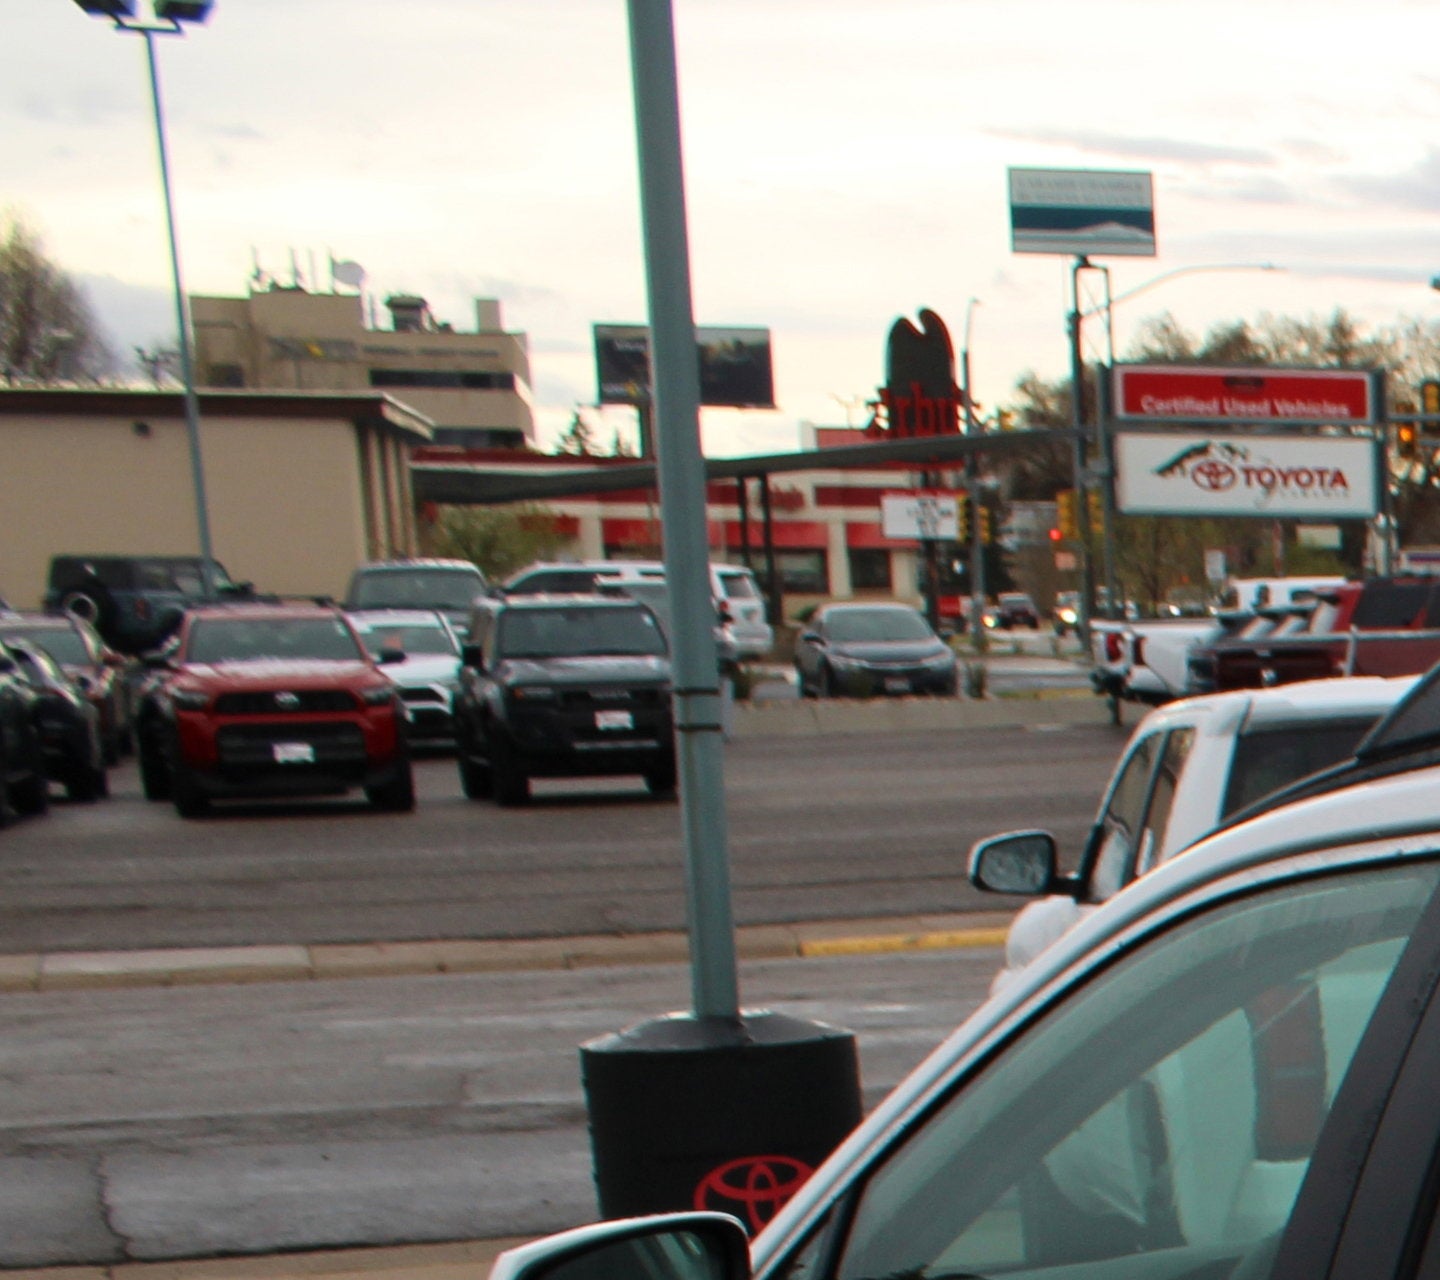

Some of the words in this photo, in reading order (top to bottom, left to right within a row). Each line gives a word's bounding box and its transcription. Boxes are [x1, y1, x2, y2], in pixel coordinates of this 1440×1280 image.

[1140, 395, 1220, 415] Certified
[1222, 397, 1271, 417] Used
[1273, 398, 1350, 418] Vehicles
[1241, 466, 1349, 490] TOYOTA
